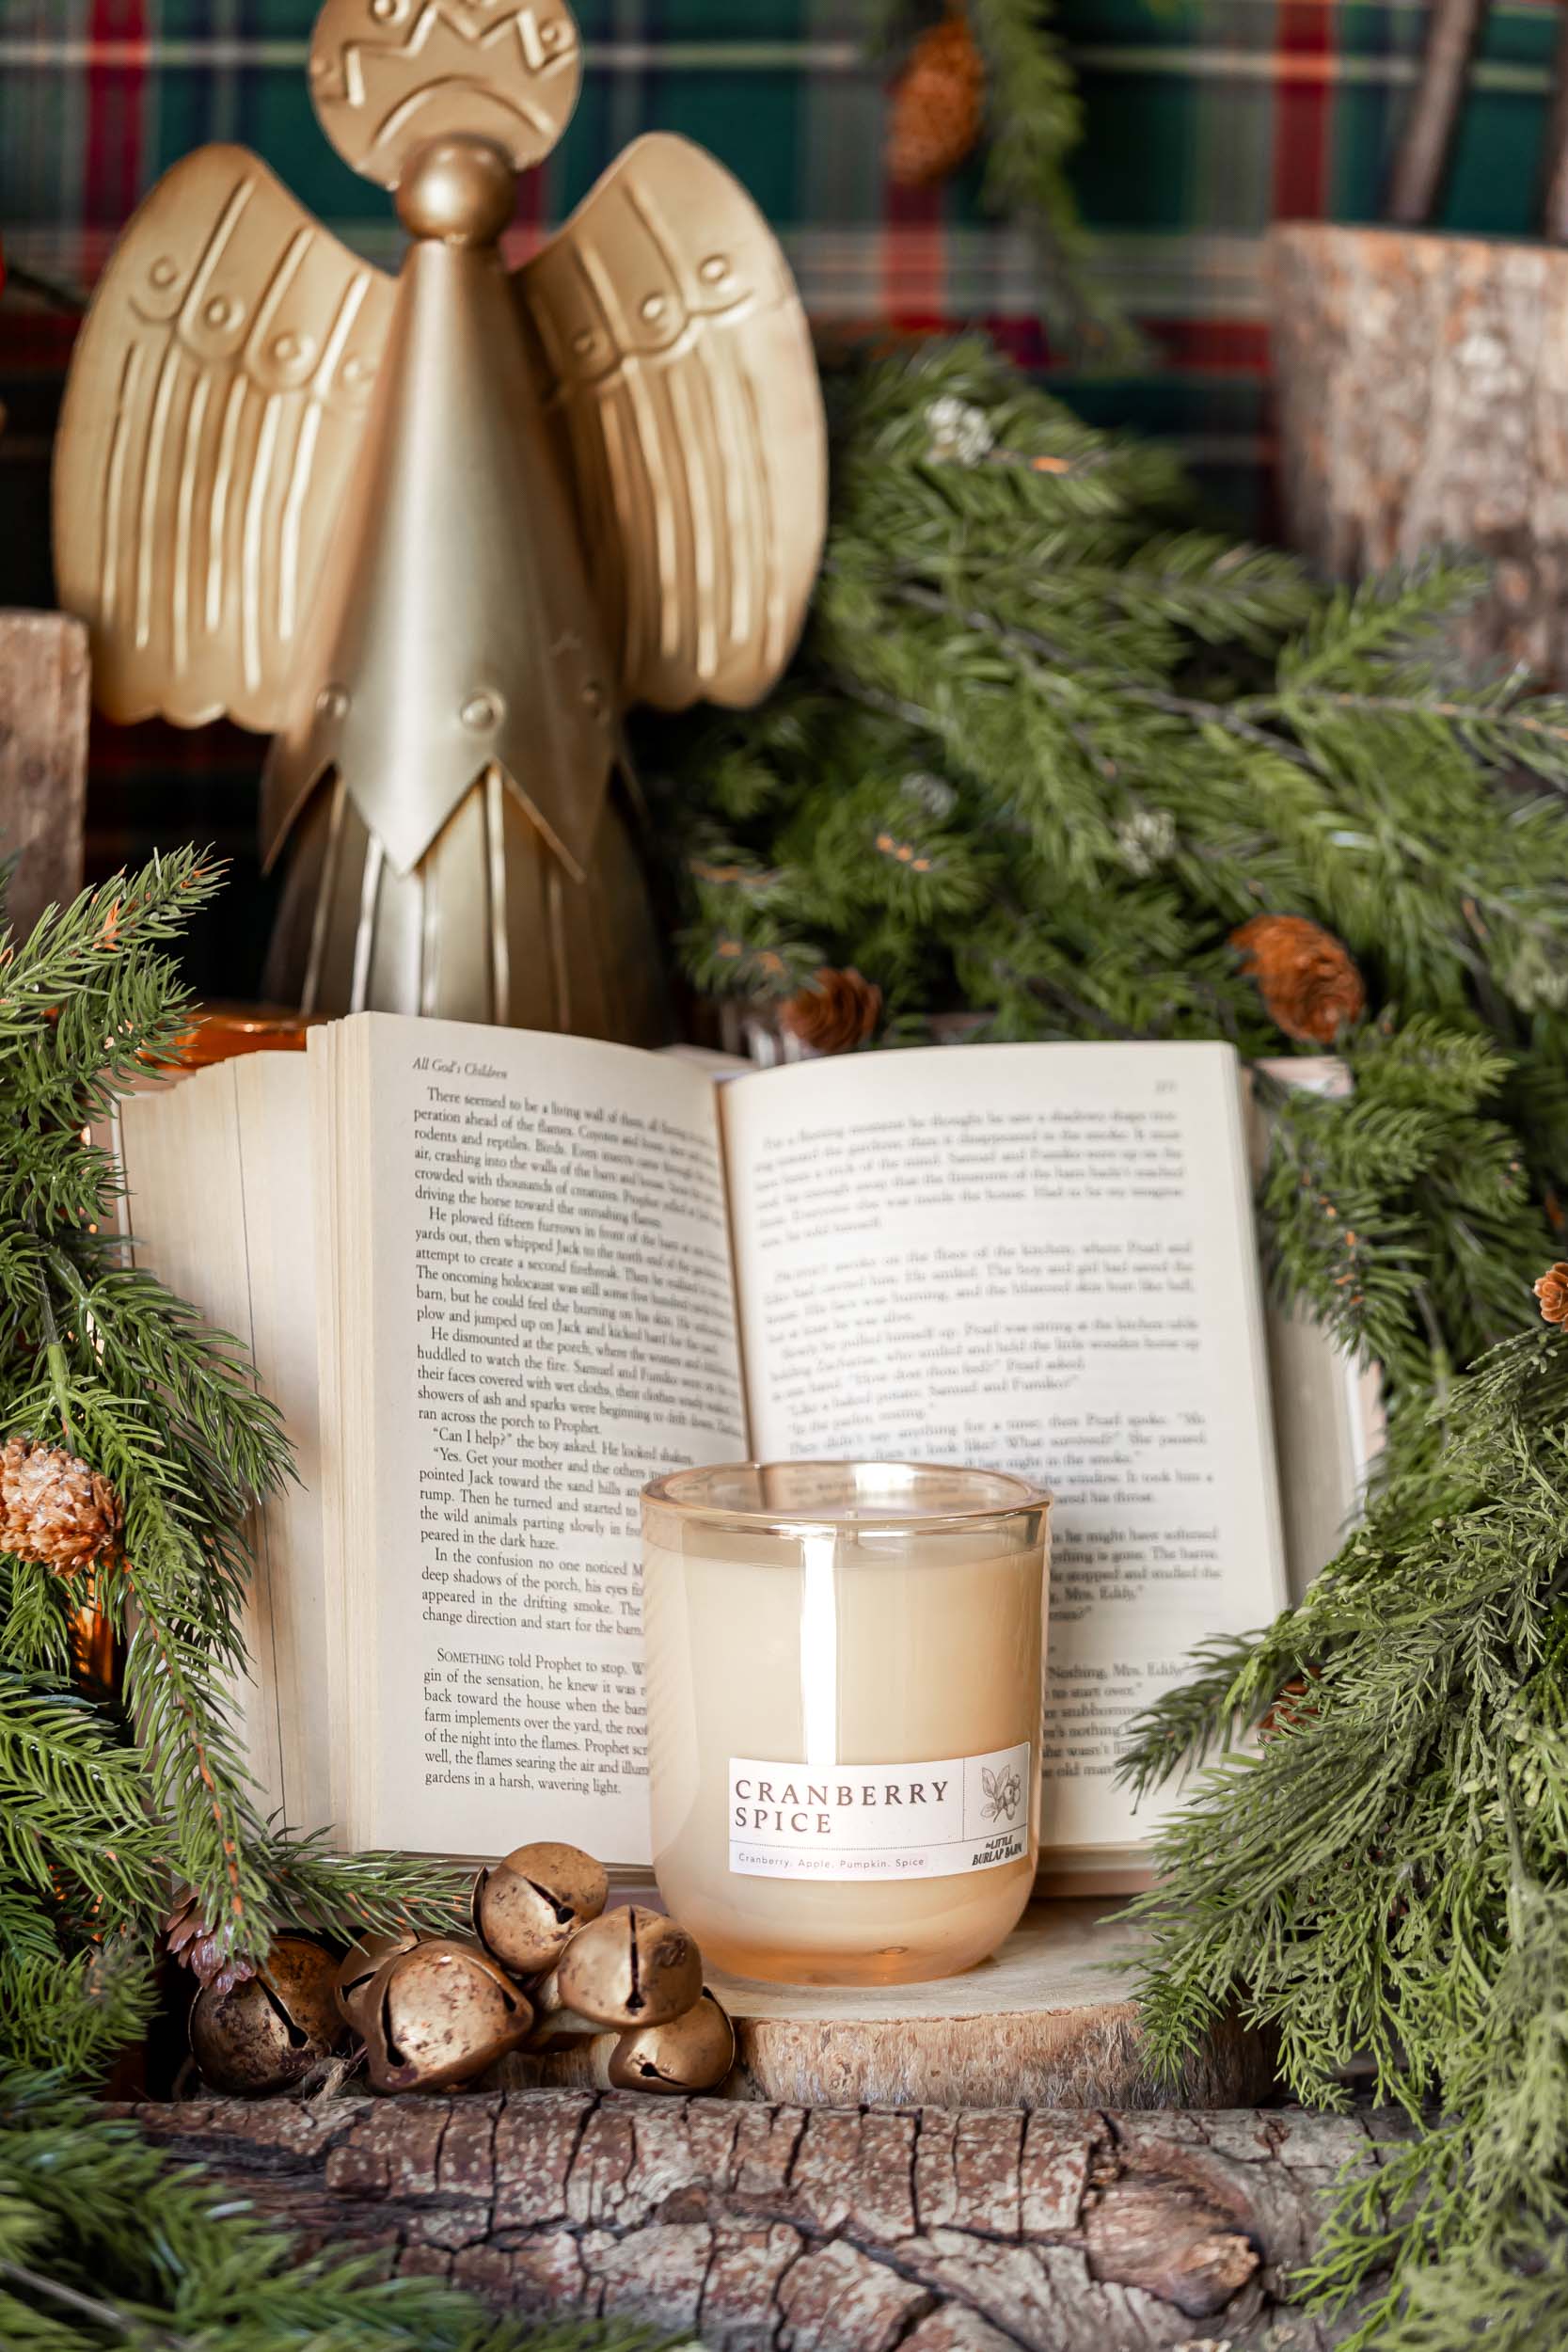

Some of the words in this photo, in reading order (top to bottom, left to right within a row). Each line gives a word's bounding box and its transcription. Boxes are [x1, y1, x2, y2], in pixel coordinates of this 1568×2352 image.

[412, 1057, 430, 1071] All
[464, 1062, 508, 1080] Children
[426, 1086, 461, 1104] There
[464, 1094, 506, 1109] seemed
[509, 1100, 522, 1111] to
[414, 1109, 461, 1124] peration
[465, 1110, 499, 1129] ahead
[500, 1115, 514, 1130] of
[414, 1125, 457, 1143] rodents
[461, 1131, 483, 1146] and
[415, 1148, 432, 1162] air,
[435, 1148, 482, 1168] crashing
[484, 1150, 508, 1168] into
[414, 1167, 464, 1184] crowded
[467, 1171, 493, 1186] with
[415, 1184, 455, 1205] driving
[458, 1189, 477, 1204] the
[480, 1190, 512, 1209] horse
[429, 1205, 447, 1222] He
[451, 1208, 494, 1227] plowed
[415, 1226, 446, 1242] yards
[449, 1232, 472, 1246] out,
[475, 1230, 500, 1247] then
[504, 1233, 554, 1254] whipped
[416, 1249, 459, 1265] attempt
[464, 1253, 476, 1264] to
[479, 1256, 514, 1268] create
[517, 1260, 524, 1269] a
[416, 1264, 438, 1280] The
[441, 1272, 499, 1289] oncoming
[416, 1283, 447, 1302] barn,
[451, 1287, 470, 1303] but
[474, 1289, 488, 1305] he
[492, 1294, 524, 1310] could
[417, 1304, 445, 1322] plow
[449, 1309, 470, 1324] and
[474, 1312, 517, 1329] jumped
[520, 1319, 536, 1332] up
[432, 1326, 449, 1342] He
[451, 1327, 519, 1348] dismounted
[417, 1343, 466, 1362] huddled
[470, 1353, 483, 1364] to
[486, 1353, 520, 1368] watch
[524, 1355, 543, 1371] the
[418, 1364, 445, 1380] their
[448, 1367, 476, 1384] faces
[479, 1373, 524, 1389] covered
[526, 1375, 551, 1391] with
[418, 1385, 465, 1403] showers
[467, 1389, 481, 1405] of
[483, 1391, 501, 1406] ash
[505, 1393, 527, 1408] and
[419, 1409, 436, 1421] ran
[441, 1412, 476, 1423] across
[480, 1410, 498, 1425] the
[501, 1414, 535, 1430] porch
[538, 1419, 550, 1430] to
[467, 1429, 471, 1443] I
[516, 1433, 535, 1449] the
[466, 1450, 488, 1465] Get
[492, 1456, 518, 1468] your
[521, 1455, 563, 1471] mother
[420, 1468, 465, 1483] pointed
[467, 1470, 494, 1486] Jack
[499, 1474, 540, 1489] toward
[544, 1475, 563, 1491] the
[420, 1490, 454, 1505] rump.
[459, 1488, 490, 1504] Then
[495, 1491, 509, 1506] he
[513, 1495, 552, 1510] turned
[420, 1505, 438, 1520] the
[443, 1508, 469, 1523] wild
[474, 1512, 518, 1527] animals
[420, 1528, 459, 1543] peared
[463, 1532, 474, 1544] in
[478, 1530, 497, 1546] the
[499, 1532, 526, 1548] dark
[436, 1547, 448, 1562] In
[452, 1548, 471, 1564] the
[476, 1553, 533, 1568] confusion
[539, 1560, 554, 1570] no
[421, 1565, 450, 1585] deep
[453, 1568, 502, 1586] shadows
[505, 1573, 517, 1587] of
[522, 1573, 540, 1589] the
[421, 1589, 475, 1605] appeared
[482, 1593, 493, 1605] in
[499, 1592, 517, 1607] the
[422, 1606, 463, 1626] change
[466, 1610, 517, 1627] direction
[521, 1613, 543, 1629] and
[437, 1647, 504, 1666] SOMETHING
[509, 1653, 531, 1668] told
[423, 1670, 442, 1684] gin
[447, 1669, 458, 1683] of
[464, 1669, 482, 1685] the
[548, 1675, 562, 1691] he
[423, 1686, 452, 1703] back
[457, 1692, 499, 1706] toward
[503, 1692, 522, 1708] the
[526, 1693, 561, 1710] house
[424, 1707, 451, 1723] farm
[454, 1709, 521, 1728] implements
[524, 1719, 549, 1729] over
[424, 1728, 436, 1742] of
[440, 1728, 458, 1743] the
[461, 1730, 491, 1748] night
[494, 1735, 516, 1747] into
[520, 1733, 538, 1749] the
[425, 1748, 451, 1765] well,
[455, 1749, 473, 1765] the
[476, 1751, 513, 1768] flames
[515, 1758, 556, 1773] searing
[425, 1769, 470, 1786] gardens
[474, 1774, 485, 1786] in
[489, 1777, 496, 1787] a
[735, 1779, 948, 1806] CRANBERRY
[735, 1806, 832, 1834] SPICE
[972, 1848, 1005, 1866] BURLAP
[1005, 1841, 1022, 1859] BARN
[990, 1835, 1013, 1850] LITTLE
[895, 1858, 925, 1868] Spice
